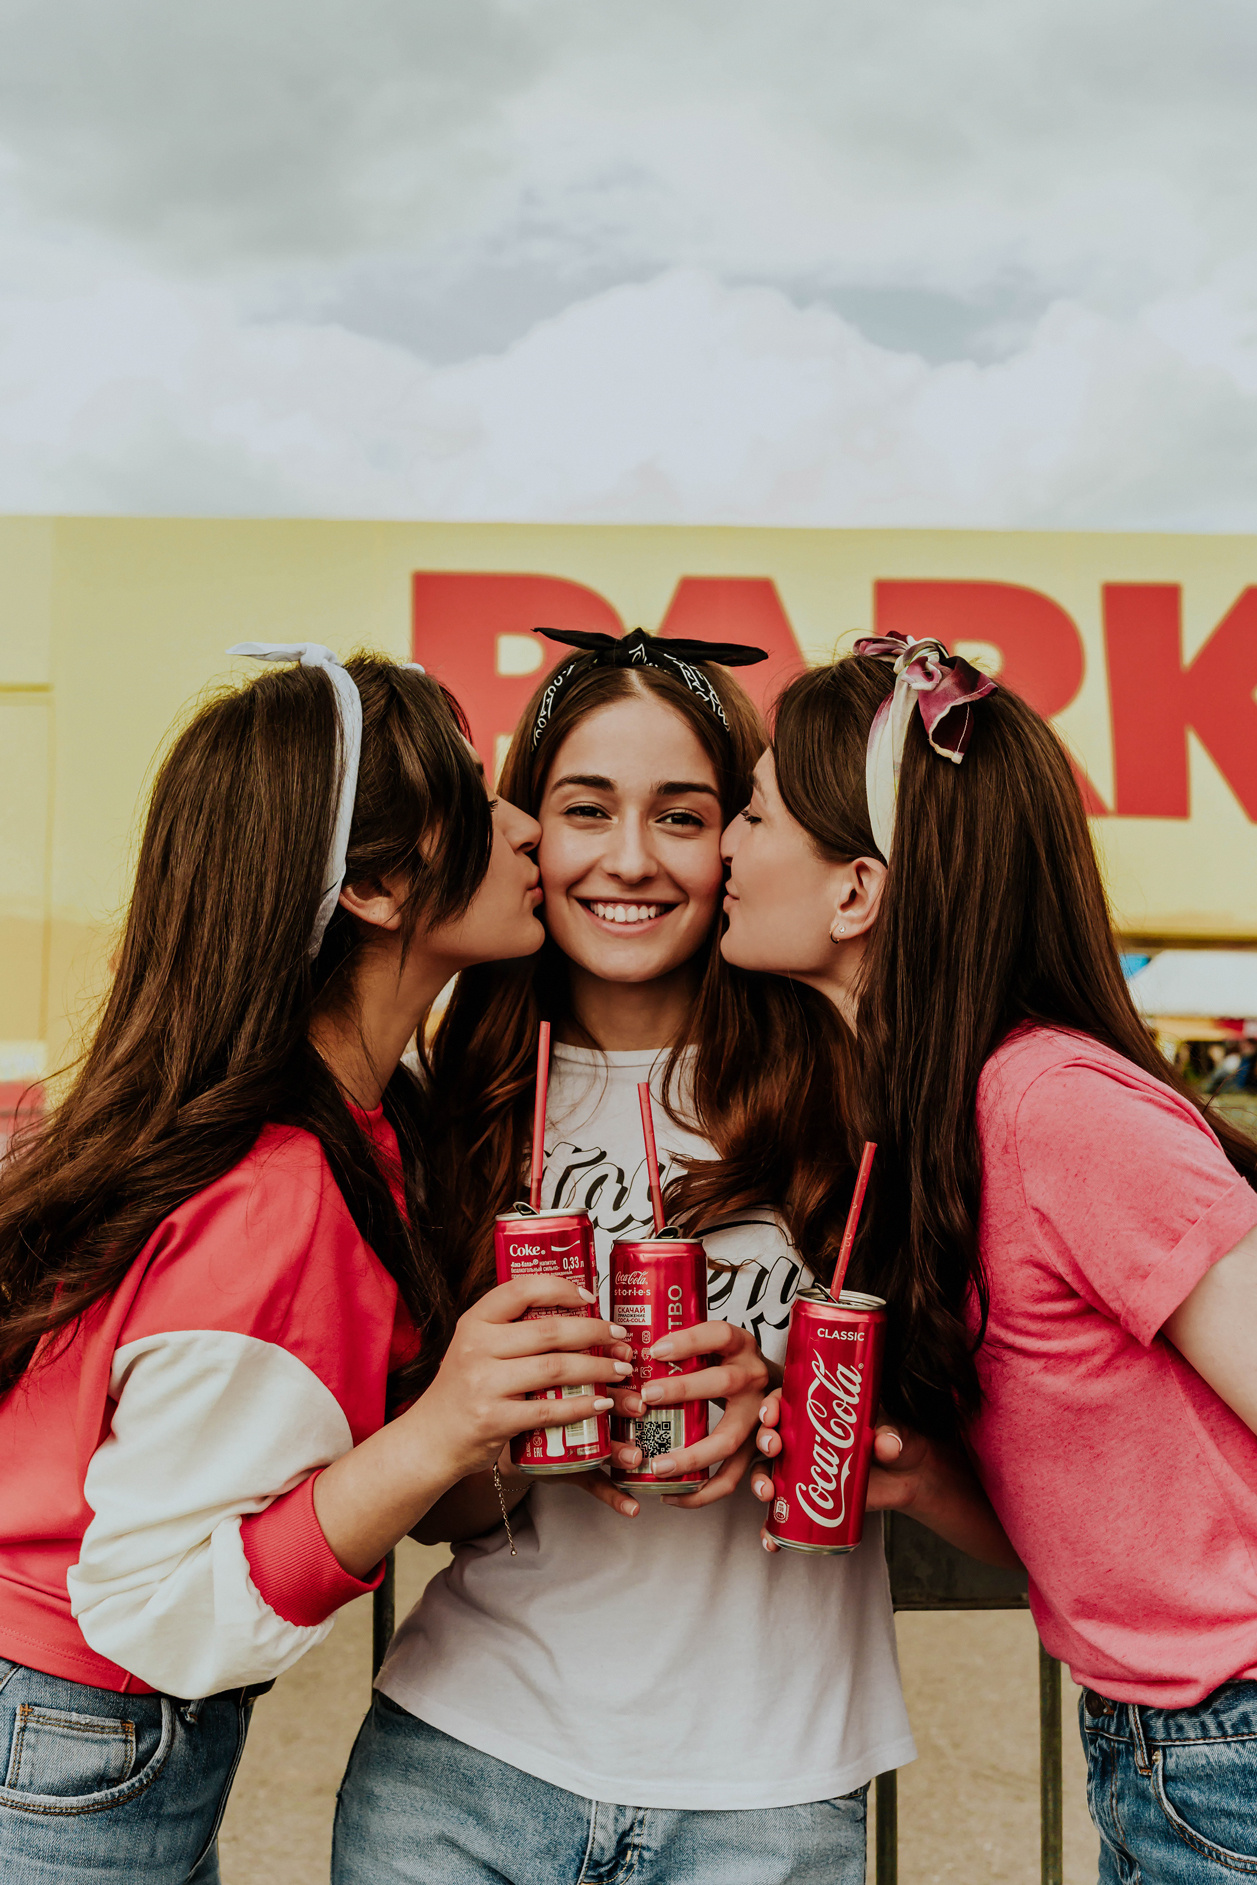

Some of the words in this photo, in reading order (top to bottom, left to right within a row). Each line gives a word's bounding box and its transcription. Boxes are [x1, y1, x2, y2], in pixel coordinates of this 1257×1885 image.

[413, 571, 1257, 821] PRK
[509, 1244, 541, 1257] Coke
[562, 1256, 579, 1272] 0,33
[817, 1327, 865, 1342] CLASSIC
[795, 1348, 863, 1528] Coca-Cola
